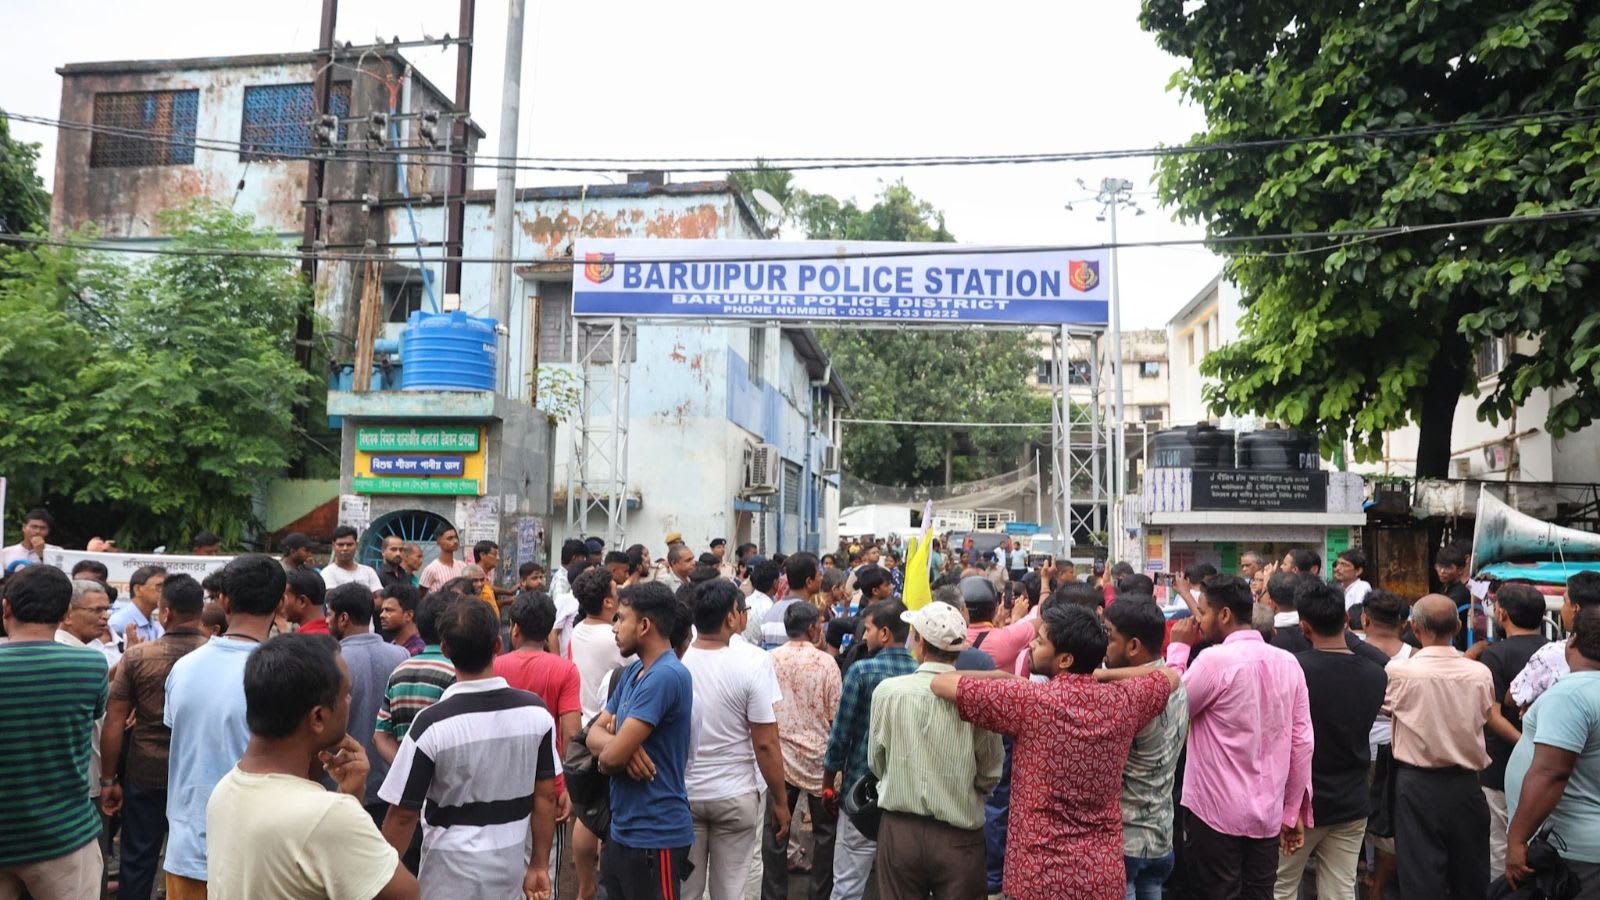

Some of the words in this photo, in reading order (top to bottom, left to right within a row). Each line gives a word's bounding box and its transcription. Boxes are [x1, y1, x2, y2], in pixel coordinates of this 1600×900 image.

[623, 262, 787, 291] BARUIPUR
[799, 264, 913, 294] POLICE
[924, 267, 1061, 297] STATION
[672, 293, 796, 305] BARUIPUR
[803, 294, 890, 307] POLICE
[898, 297, 1010, 310] DISTRICT
[723, 304, 772, 314] PHONE
[776, 305, 836, 316] NUMBER
[848, 308, 873, 316] 033
[372, 457, 393, 470] বিশুদ্ধ
[395, 457, 417, 470] শীতল
[420, 458, 442, 470] পানীয়
[444, 460, 460, 470] জল
[166, 561, 206, 571] সরকারের
